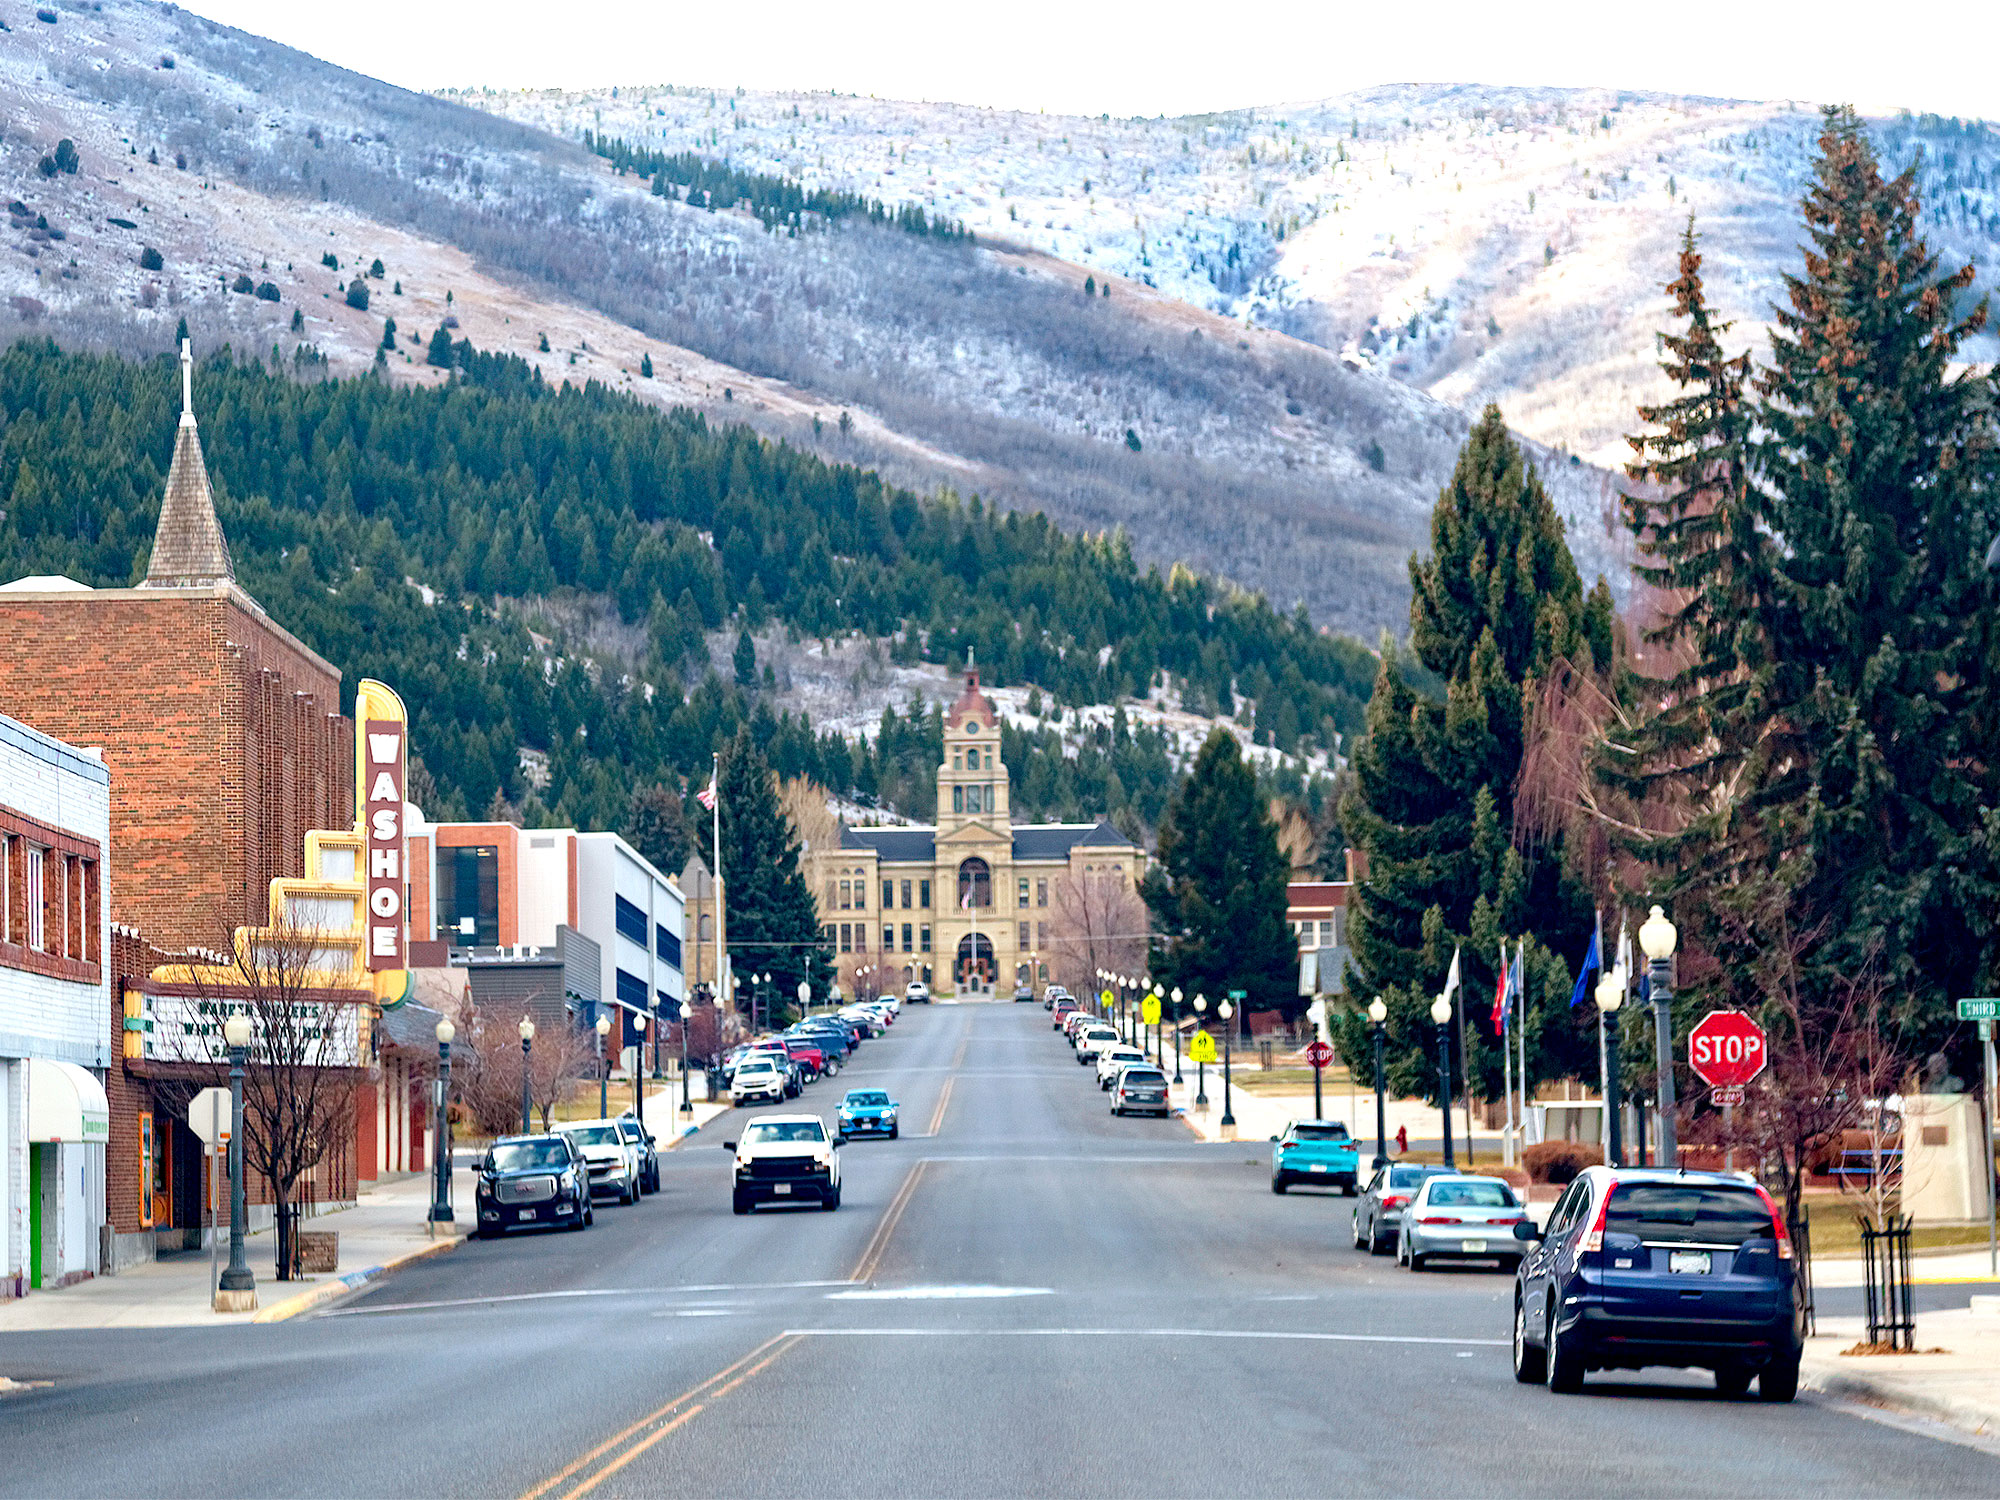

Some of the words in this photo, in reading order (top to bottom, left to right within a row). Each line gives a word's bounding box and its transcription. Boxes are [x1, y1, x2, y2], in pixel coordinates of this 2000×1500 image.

[368, 733, 400, 957] WASHOE
[1306, 1050, 1334, 1061] SOP
[1696, 1035, 1760, 1063] STOP
